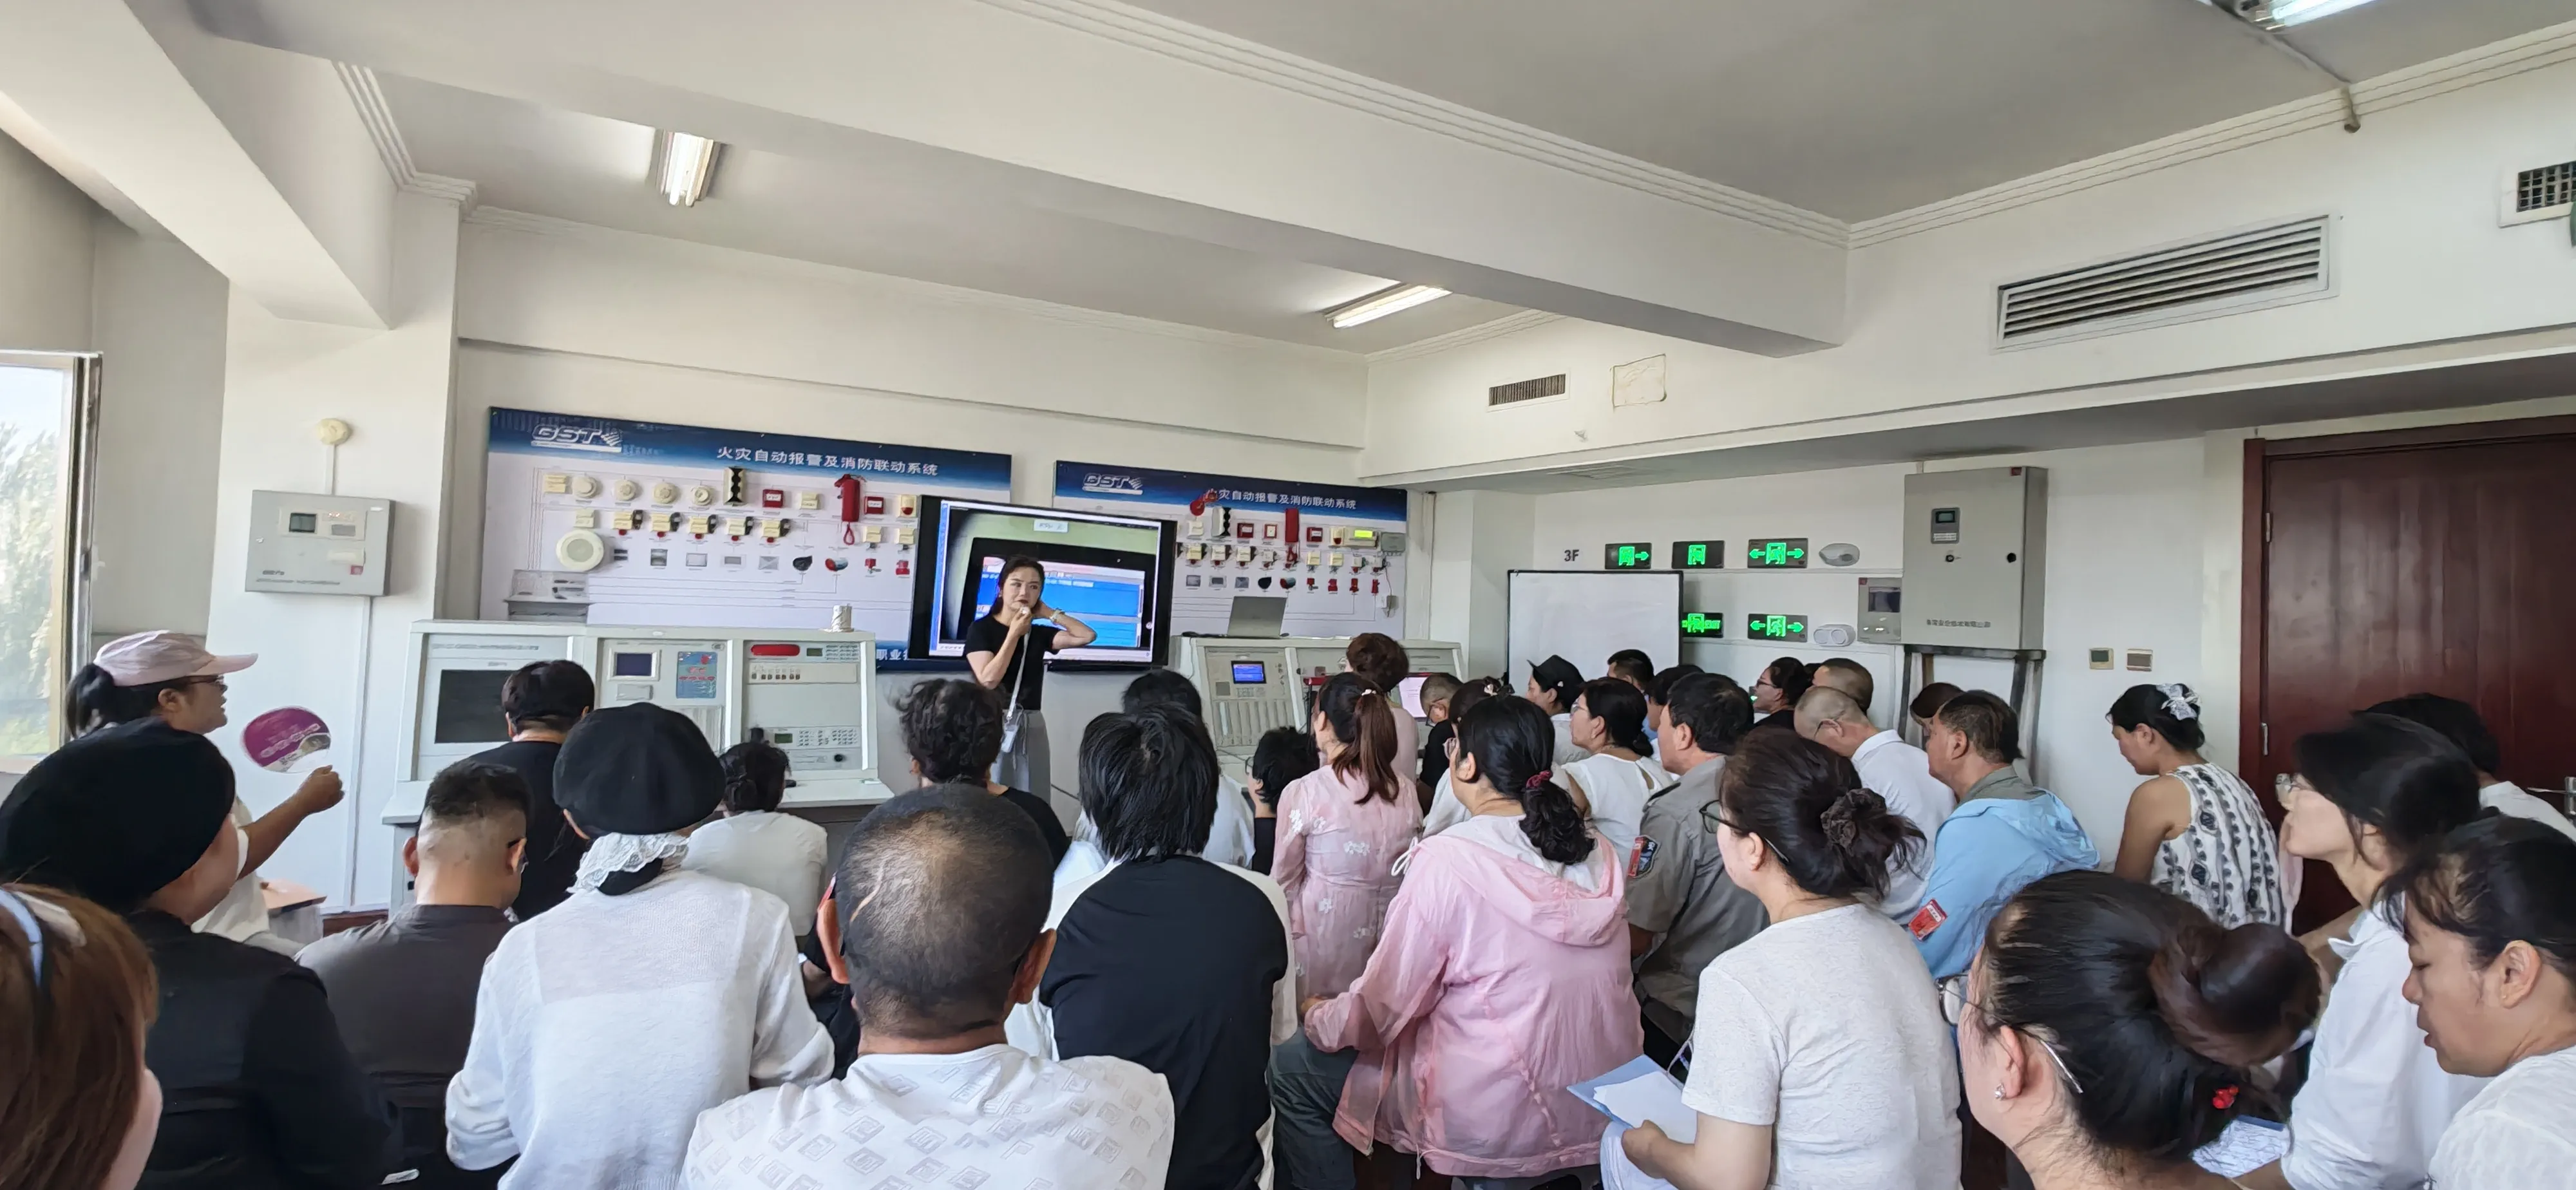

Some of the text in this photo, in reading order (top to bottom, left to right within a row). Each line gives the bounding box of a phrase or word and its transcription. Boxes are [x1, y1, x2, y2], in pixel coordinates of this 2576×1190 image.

[532, 424, 602, 444] GST
[717, 446, 938, 477] 火灾自动报警及消防联动系统
[1564, 549, 1580, 562] 3F
